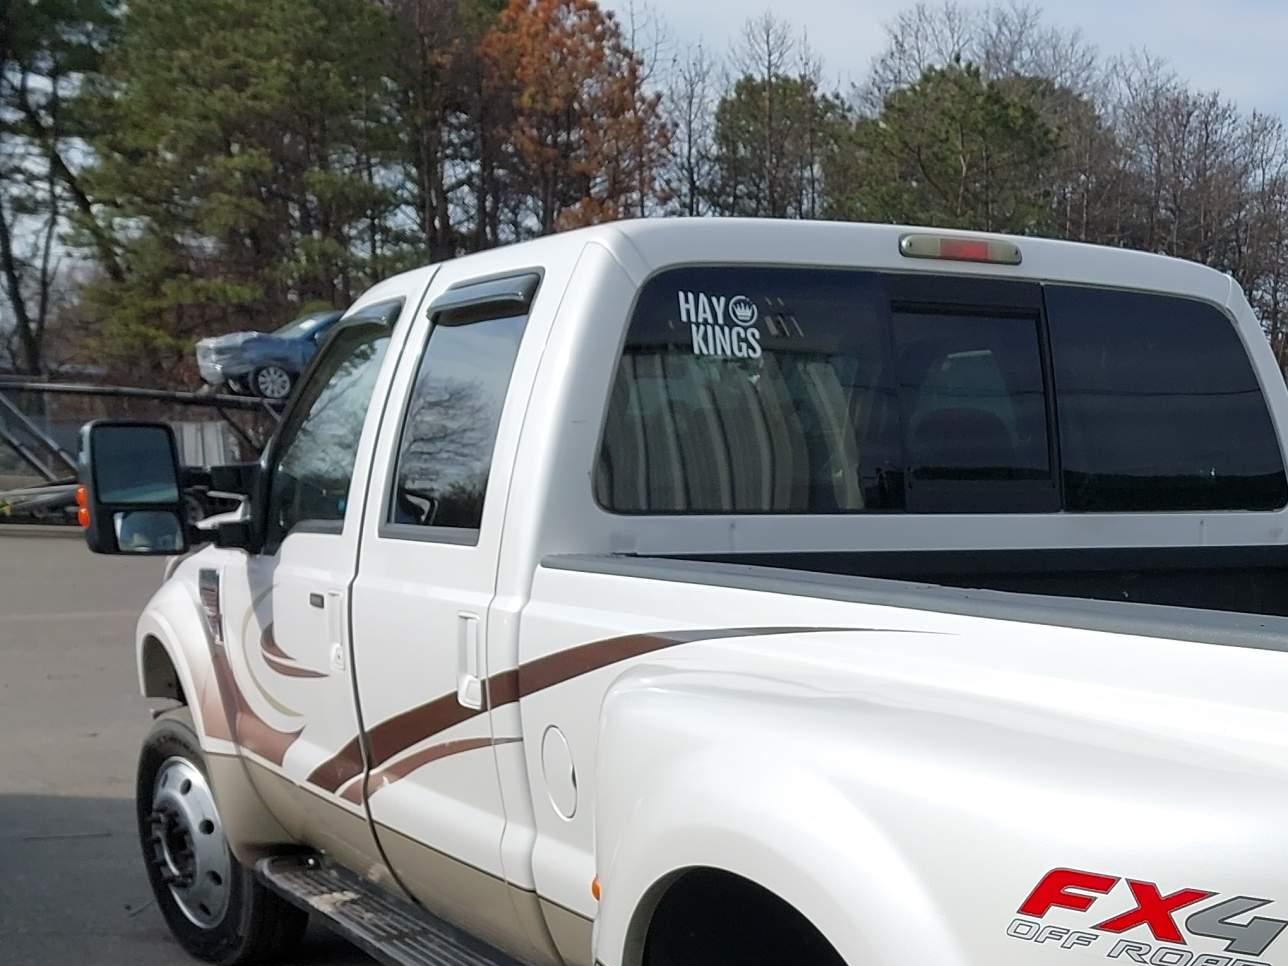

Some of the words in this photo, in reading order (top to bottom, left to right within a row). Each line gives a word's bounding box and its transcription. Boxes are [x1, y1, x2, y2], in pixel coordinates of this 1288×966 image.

[677, 290, 726, 324] HAY
[691, 323, 762, 359] KINGS
[1006, 917, 1100, 950] OFF
